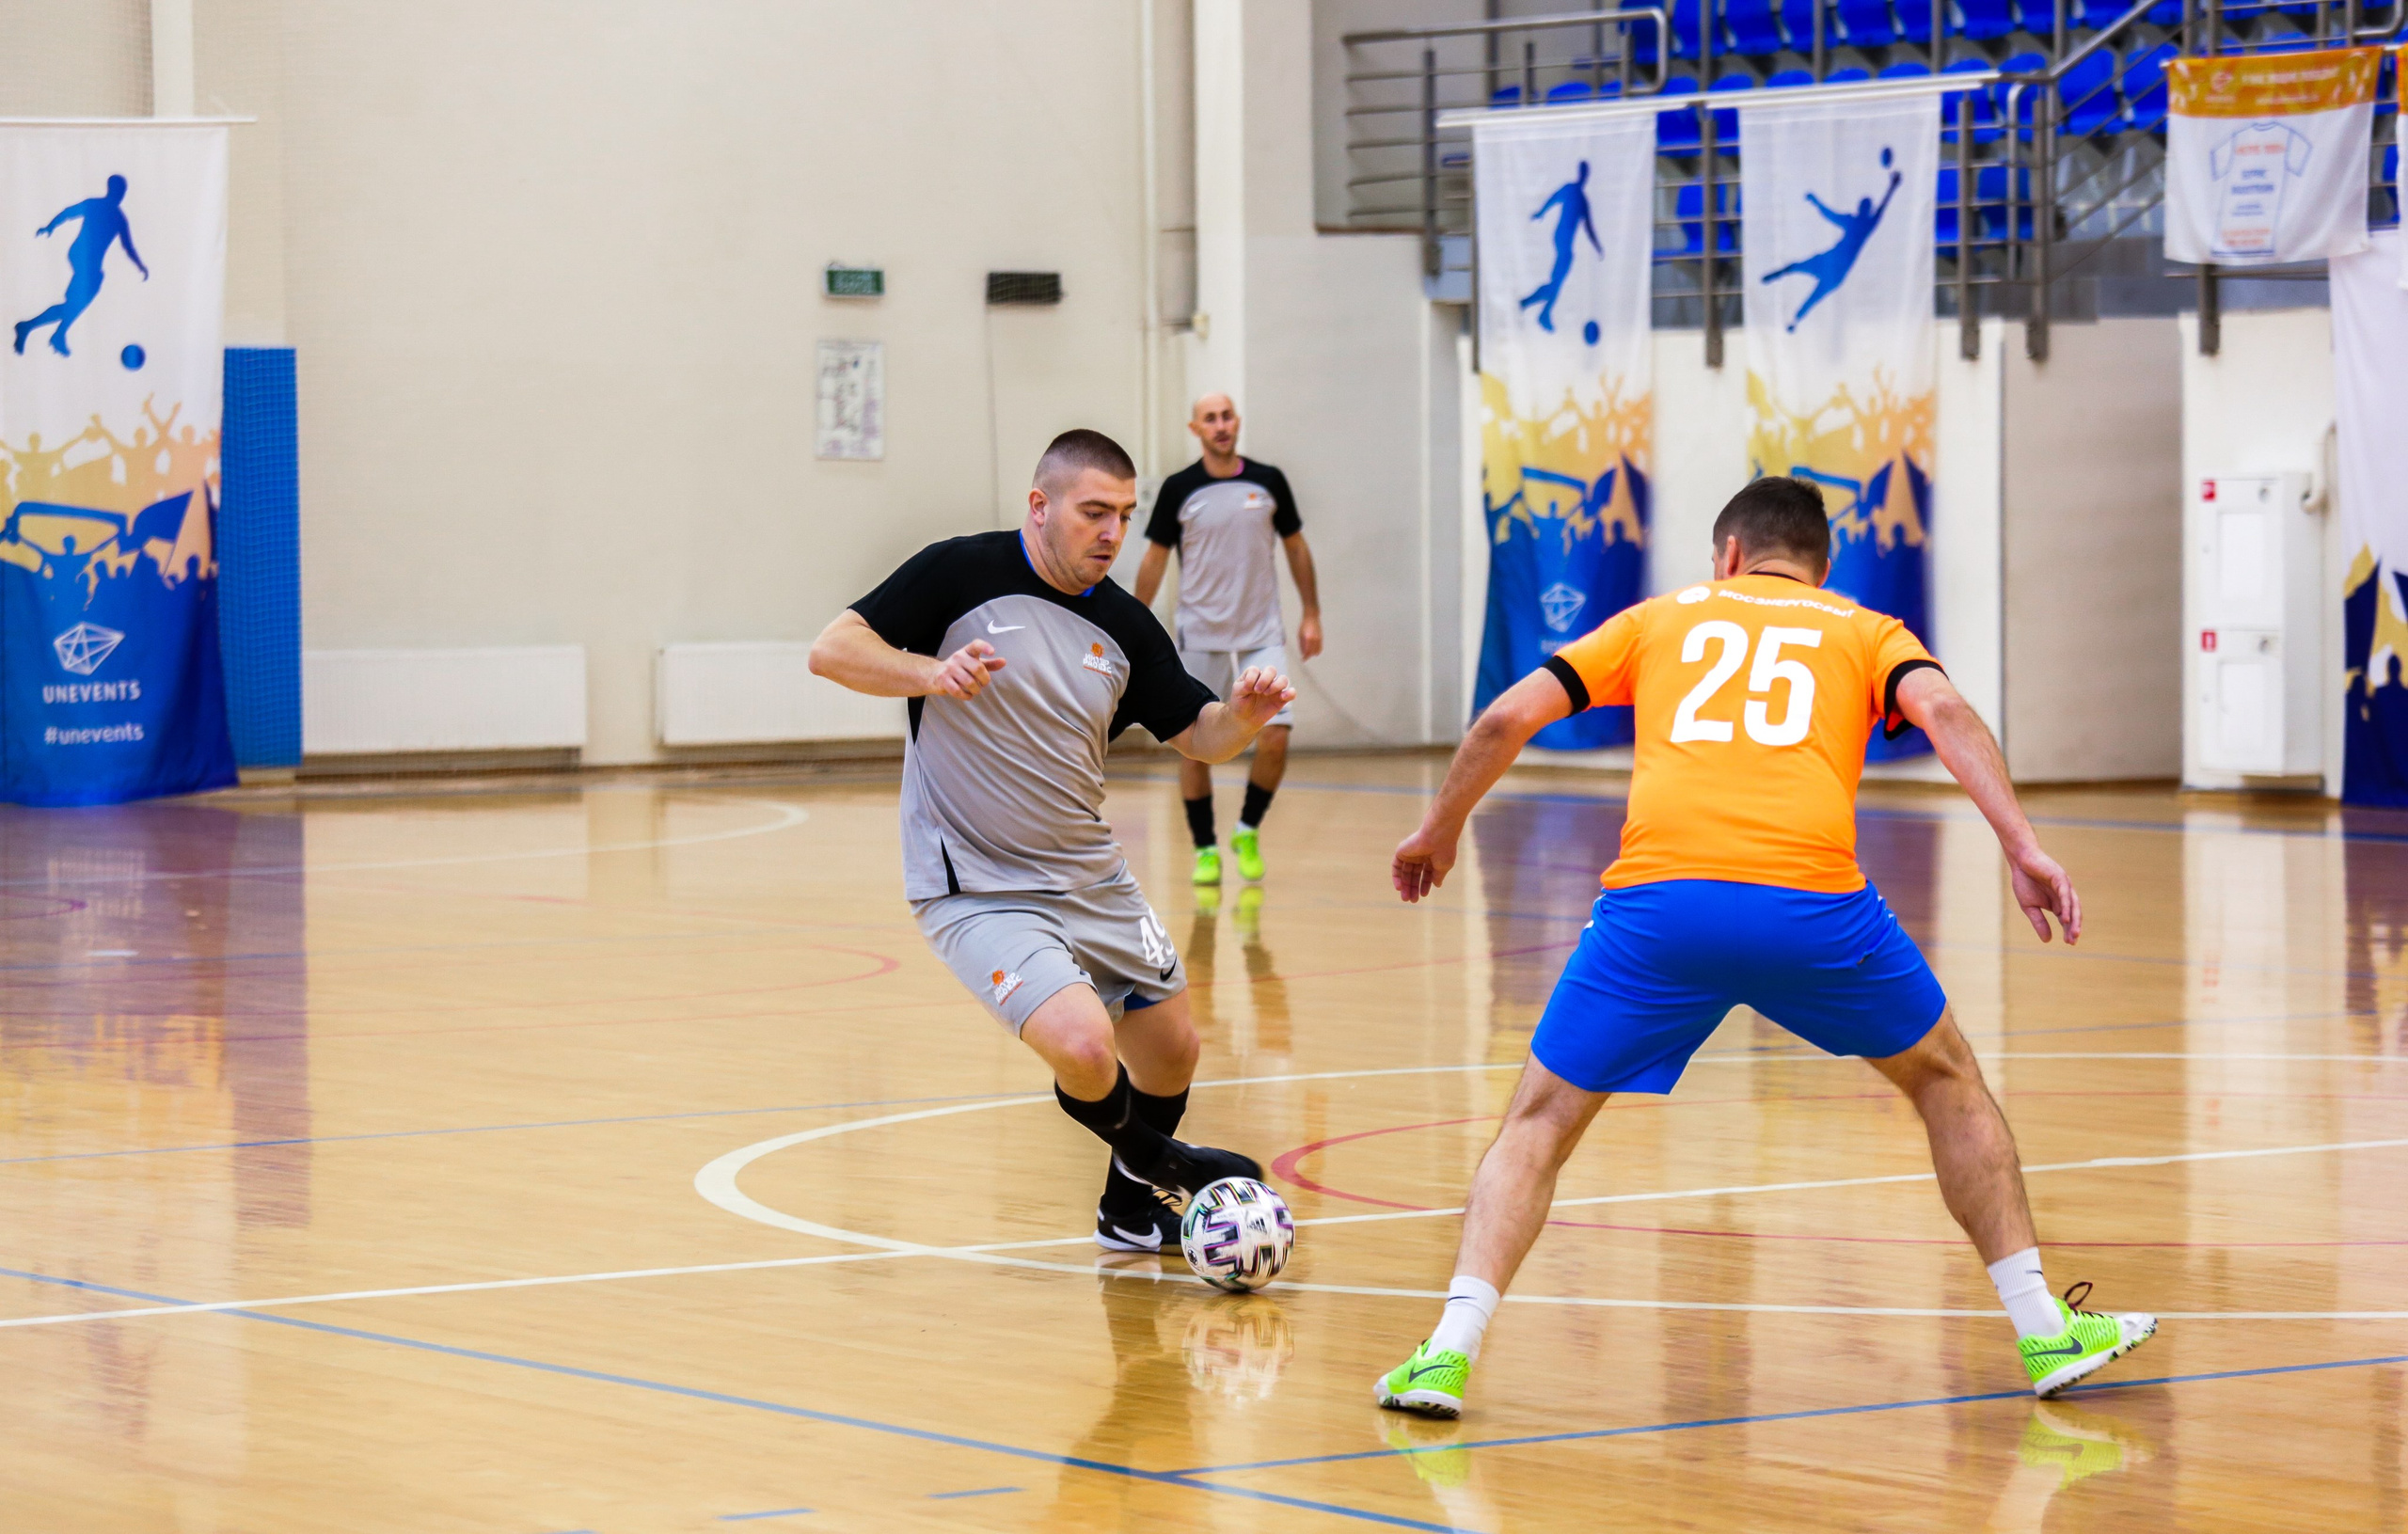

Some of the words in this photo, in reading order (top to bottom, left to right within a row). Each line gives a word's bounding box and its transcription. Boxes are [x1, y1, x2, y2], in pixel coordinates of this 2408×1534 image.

[42, 679, 142, 704] UNEVENTS
[1670, 620, 1823, 747] 25
[44, 721, 144, 746] #unevents
